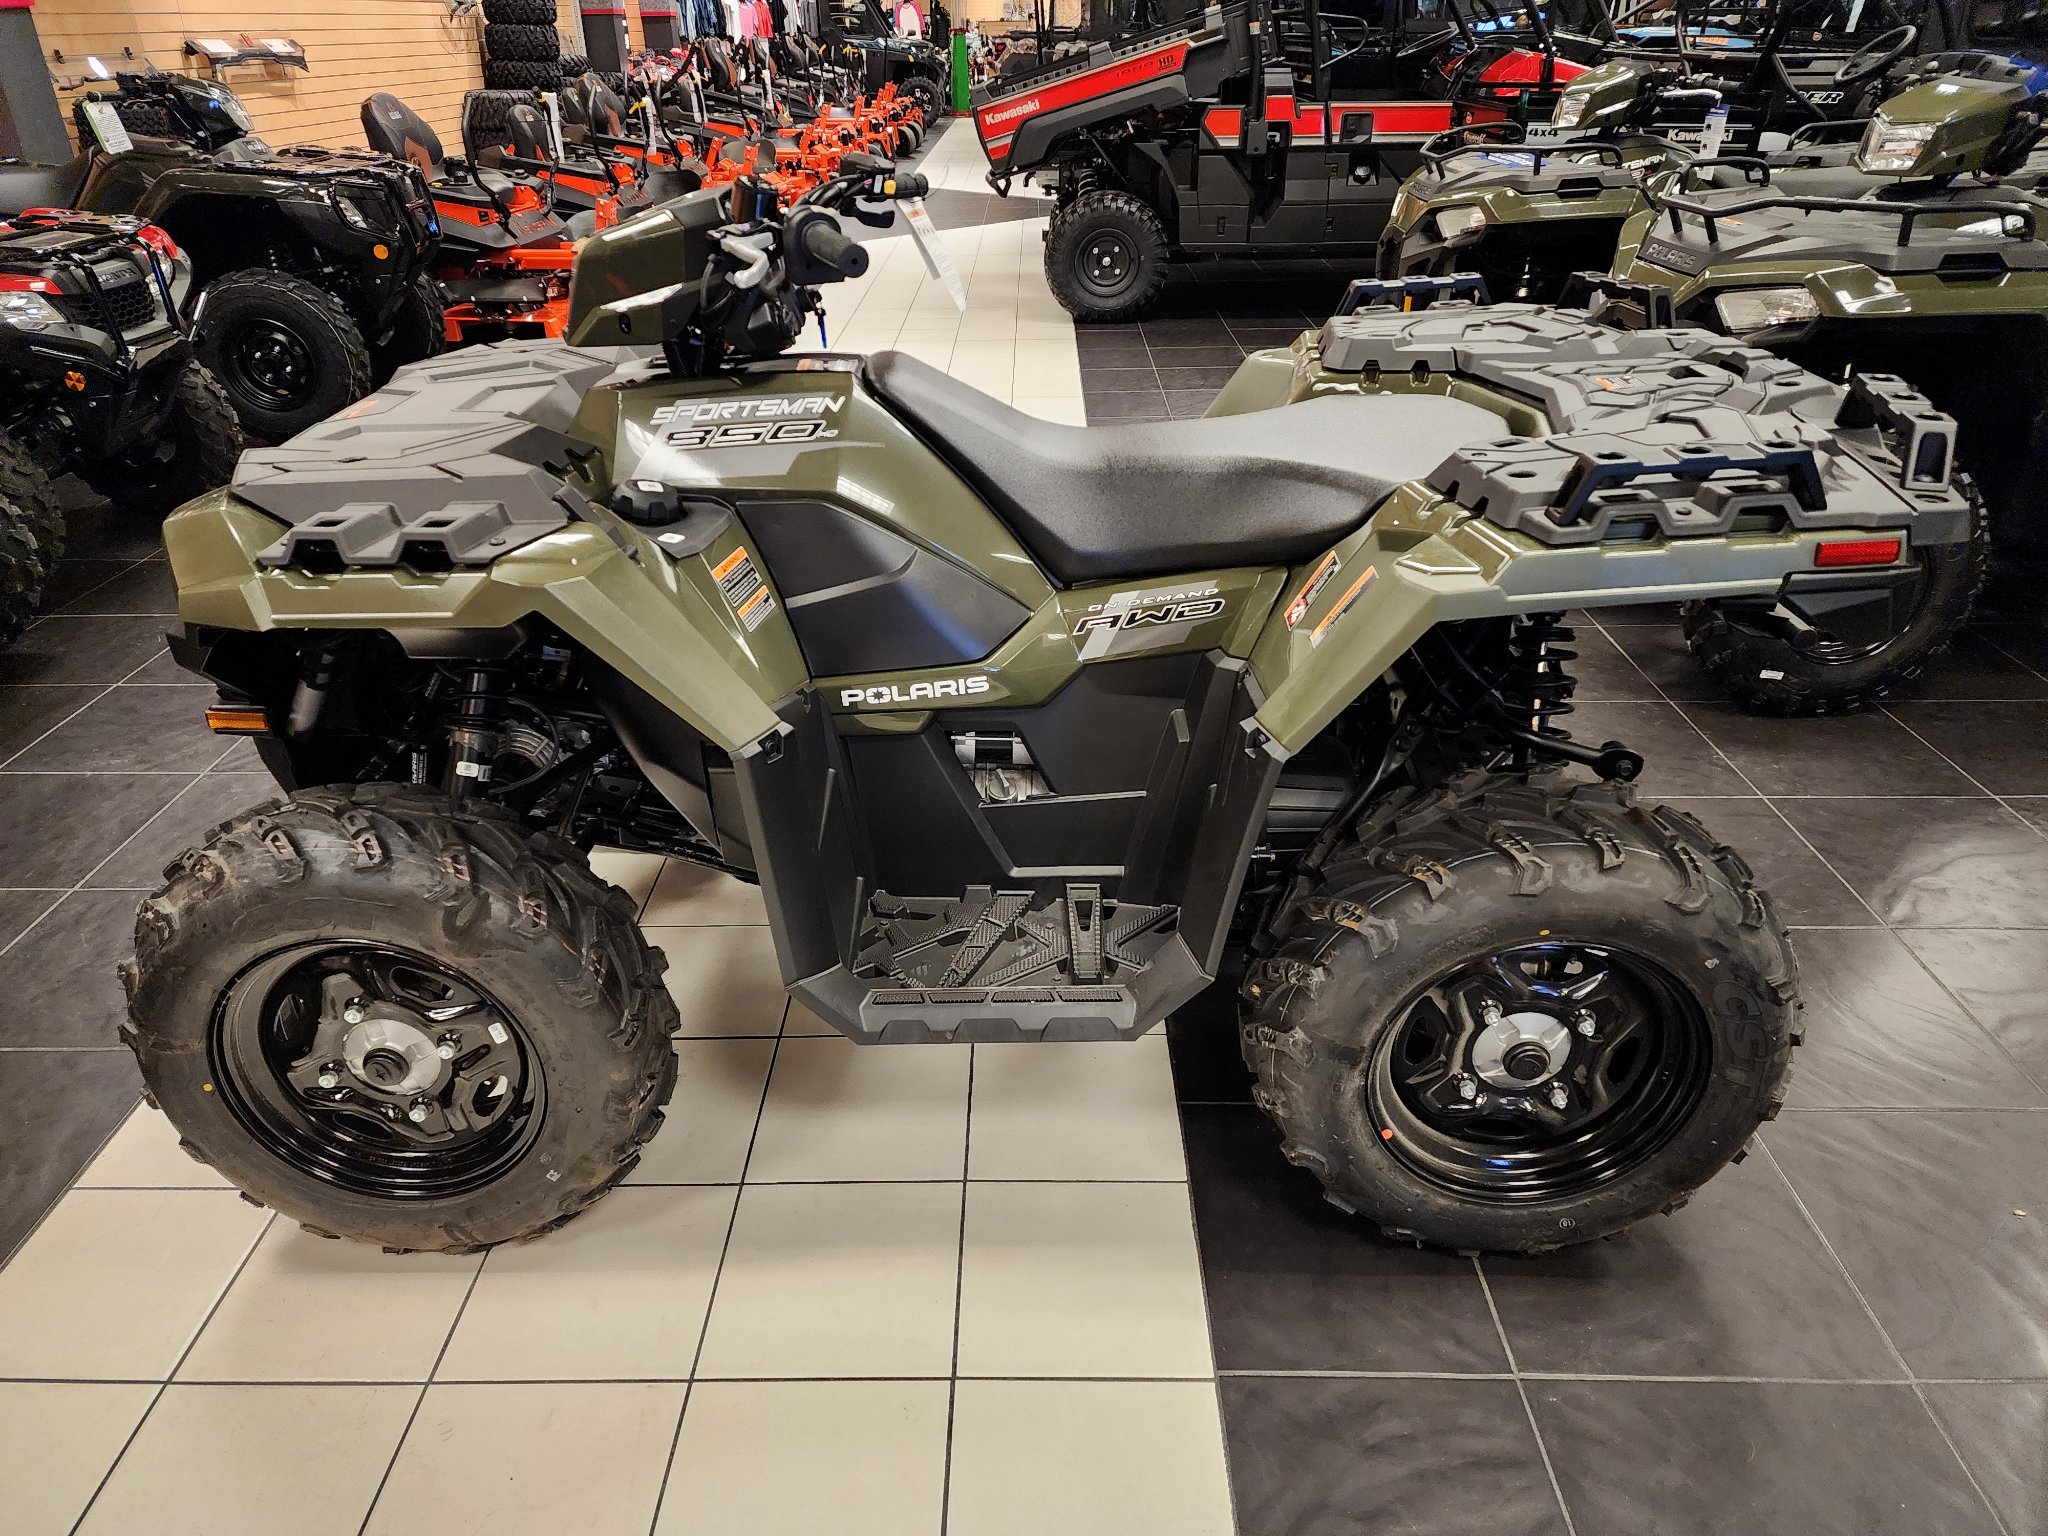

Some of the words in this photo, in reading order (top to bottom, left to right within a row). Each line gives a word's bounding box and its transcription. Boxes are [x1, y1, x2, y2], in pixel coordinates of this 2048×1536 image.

[985, 98, 1041, 126] Kawasaki
[1528, 127, 1560, 138] 4x4
[1667, 129, 1734, 142] Kawaki
[1622, 153, 1667, 169] TSMAN
[1646, 243, 1697, 268] POLARIS
[650, 396, 846, 426] SPORTSMAN
[1087, 602, 1119, 613] ON
[1127, 587, 1221, 606] DEMAND
[1072, 598, 1226, 636] AWD
[840, 675, 990, 707] POLARIS
